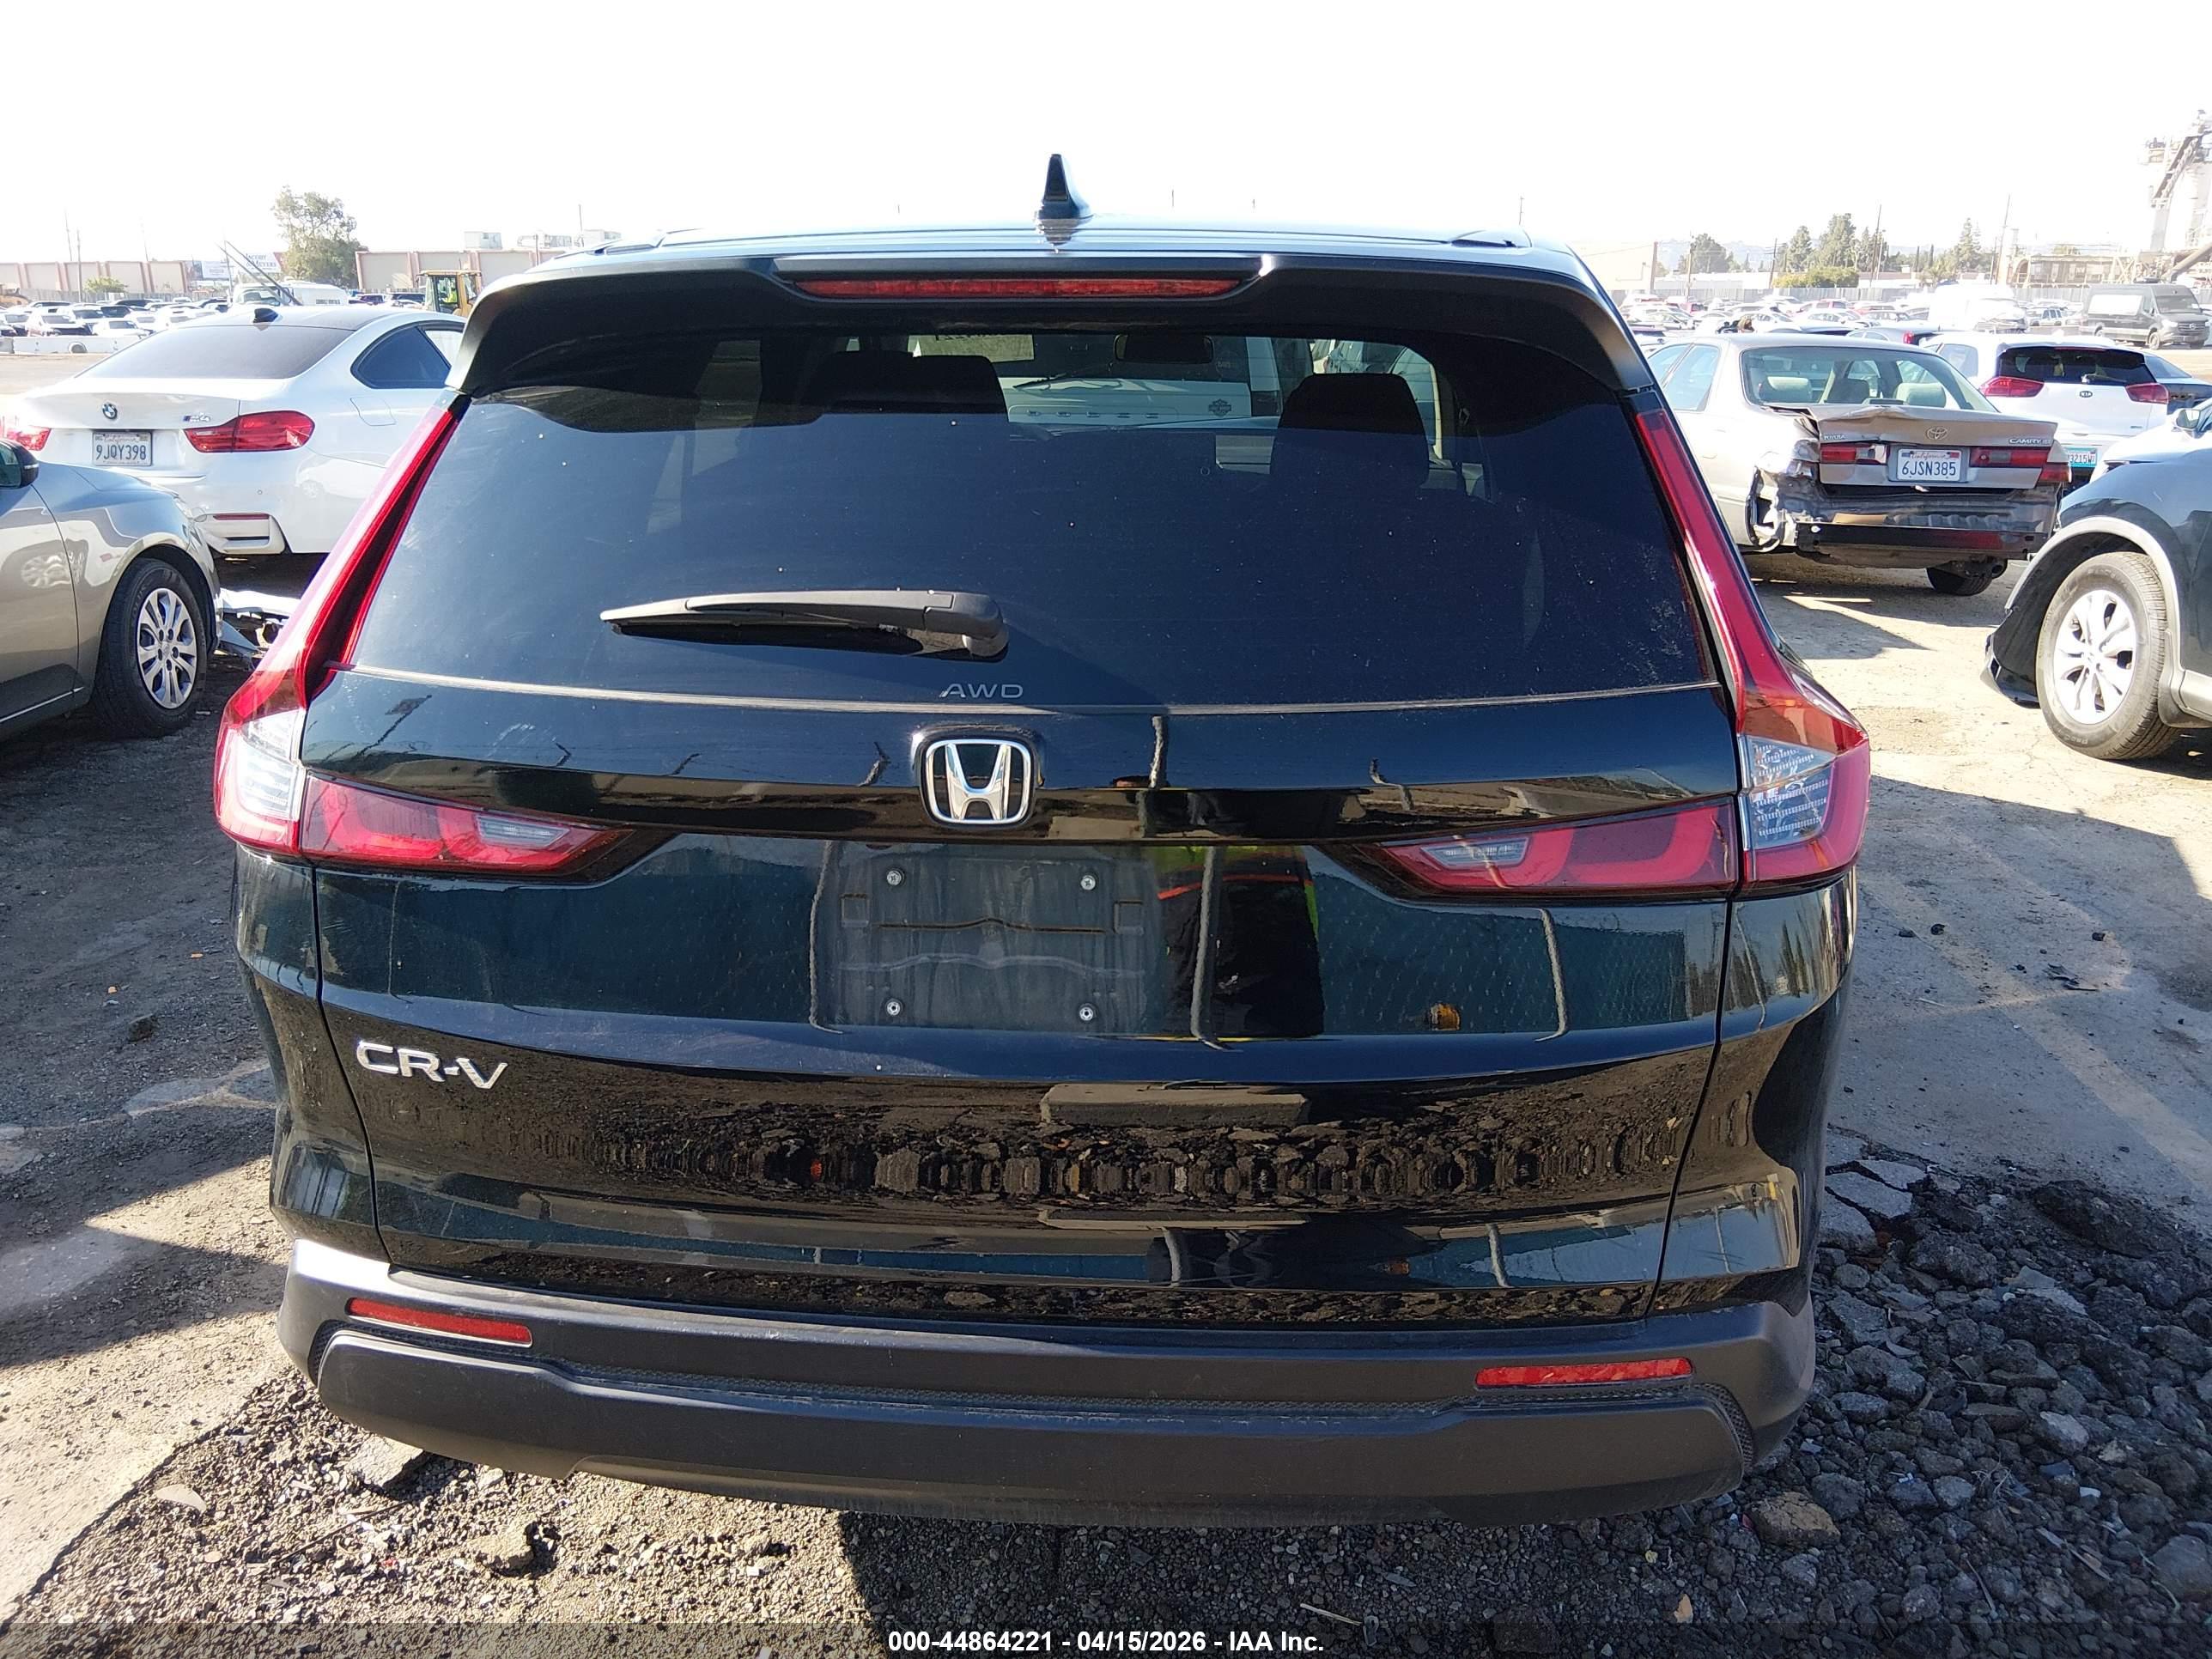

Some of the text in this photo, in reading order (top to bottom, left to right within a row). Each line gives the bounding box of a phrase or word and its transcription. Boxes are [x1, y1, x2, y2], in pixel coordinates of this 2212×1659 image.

[96, 445, 147, 460] 9JQY398
[1902, 461, 1956, 476] 6JSN385
[939, 684, 1024, 698] AWD
[356, 1040, 508, 1089] CR-V
